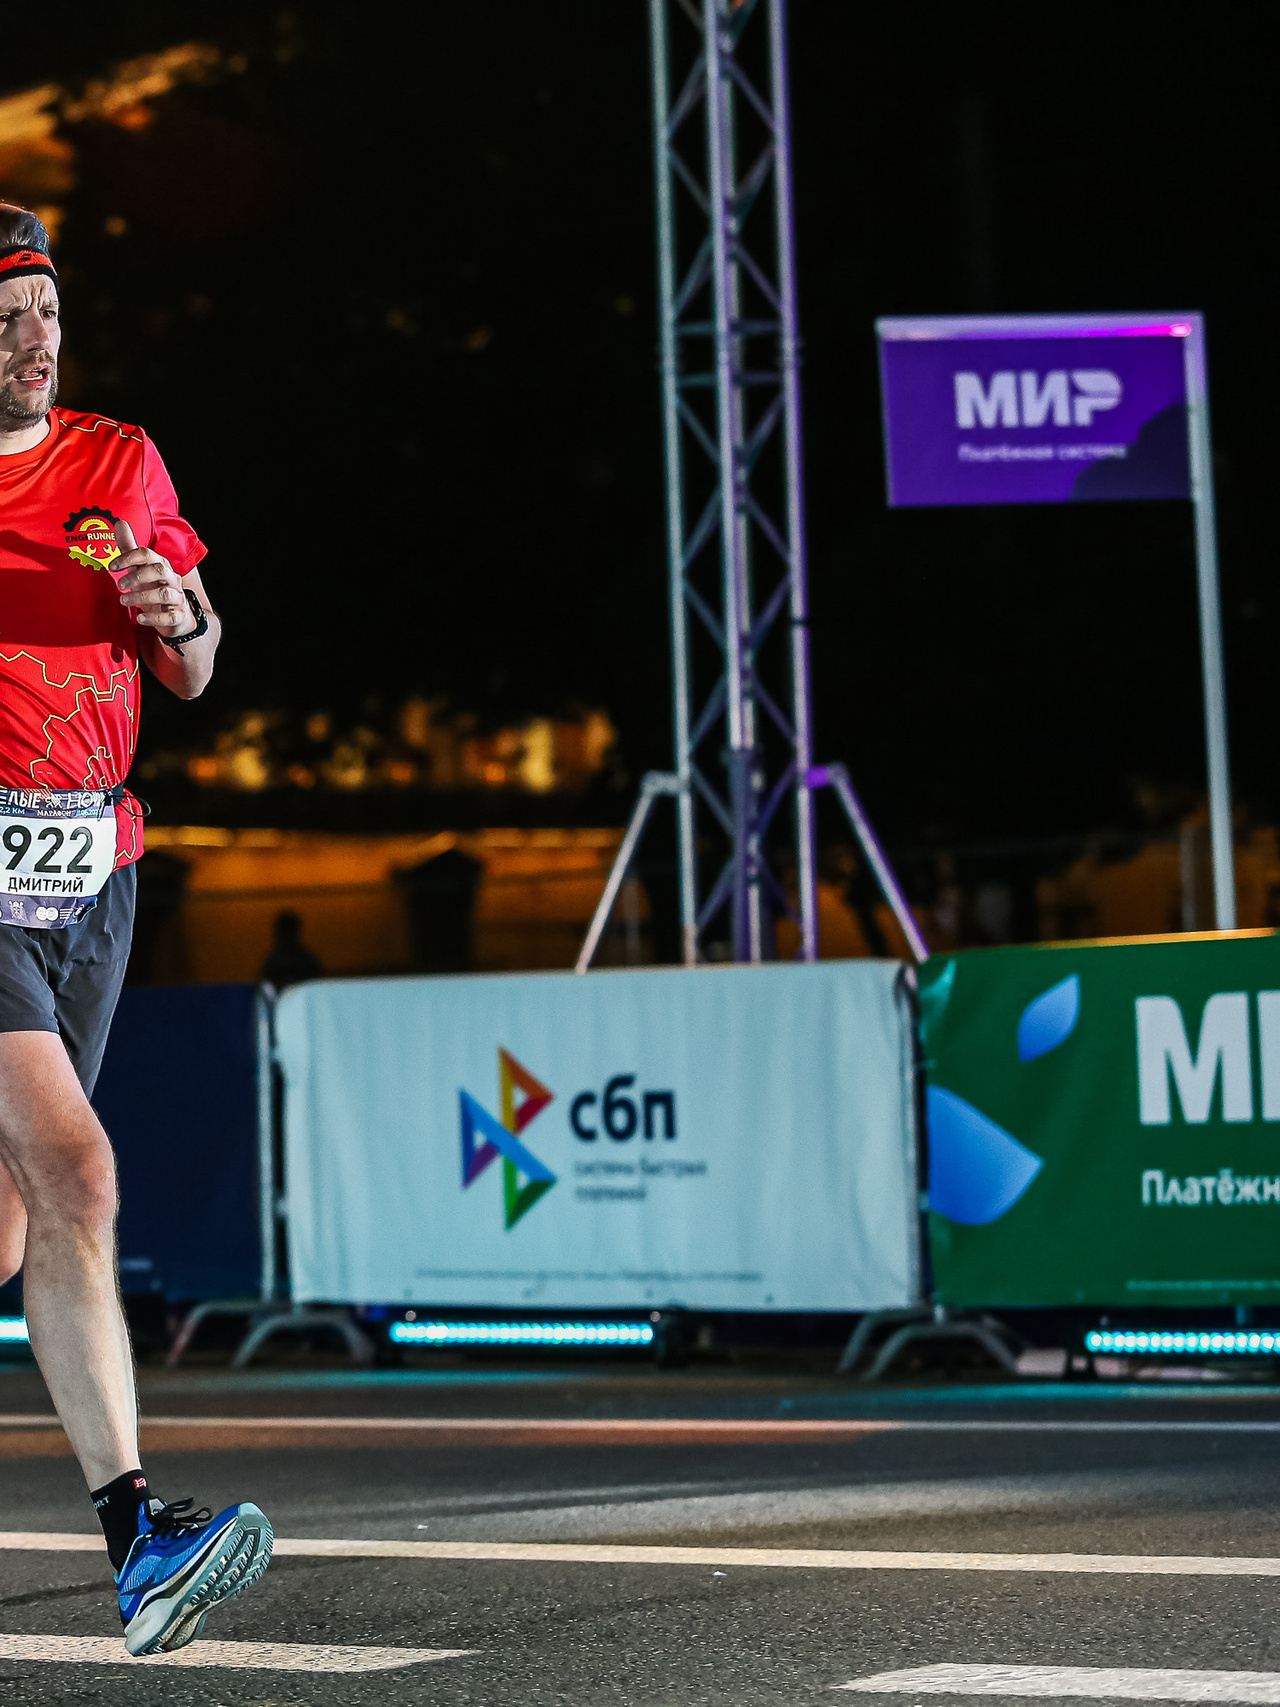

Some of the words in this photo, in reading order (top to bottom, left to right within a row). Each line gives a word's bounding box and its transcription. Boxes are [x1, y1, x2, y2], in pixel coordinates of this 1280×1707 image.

[954, 368, 1124, 429] МИР
[3, 825, 94, 874] 922
[7, 877, 84, 893] ДМИТРИЙ
